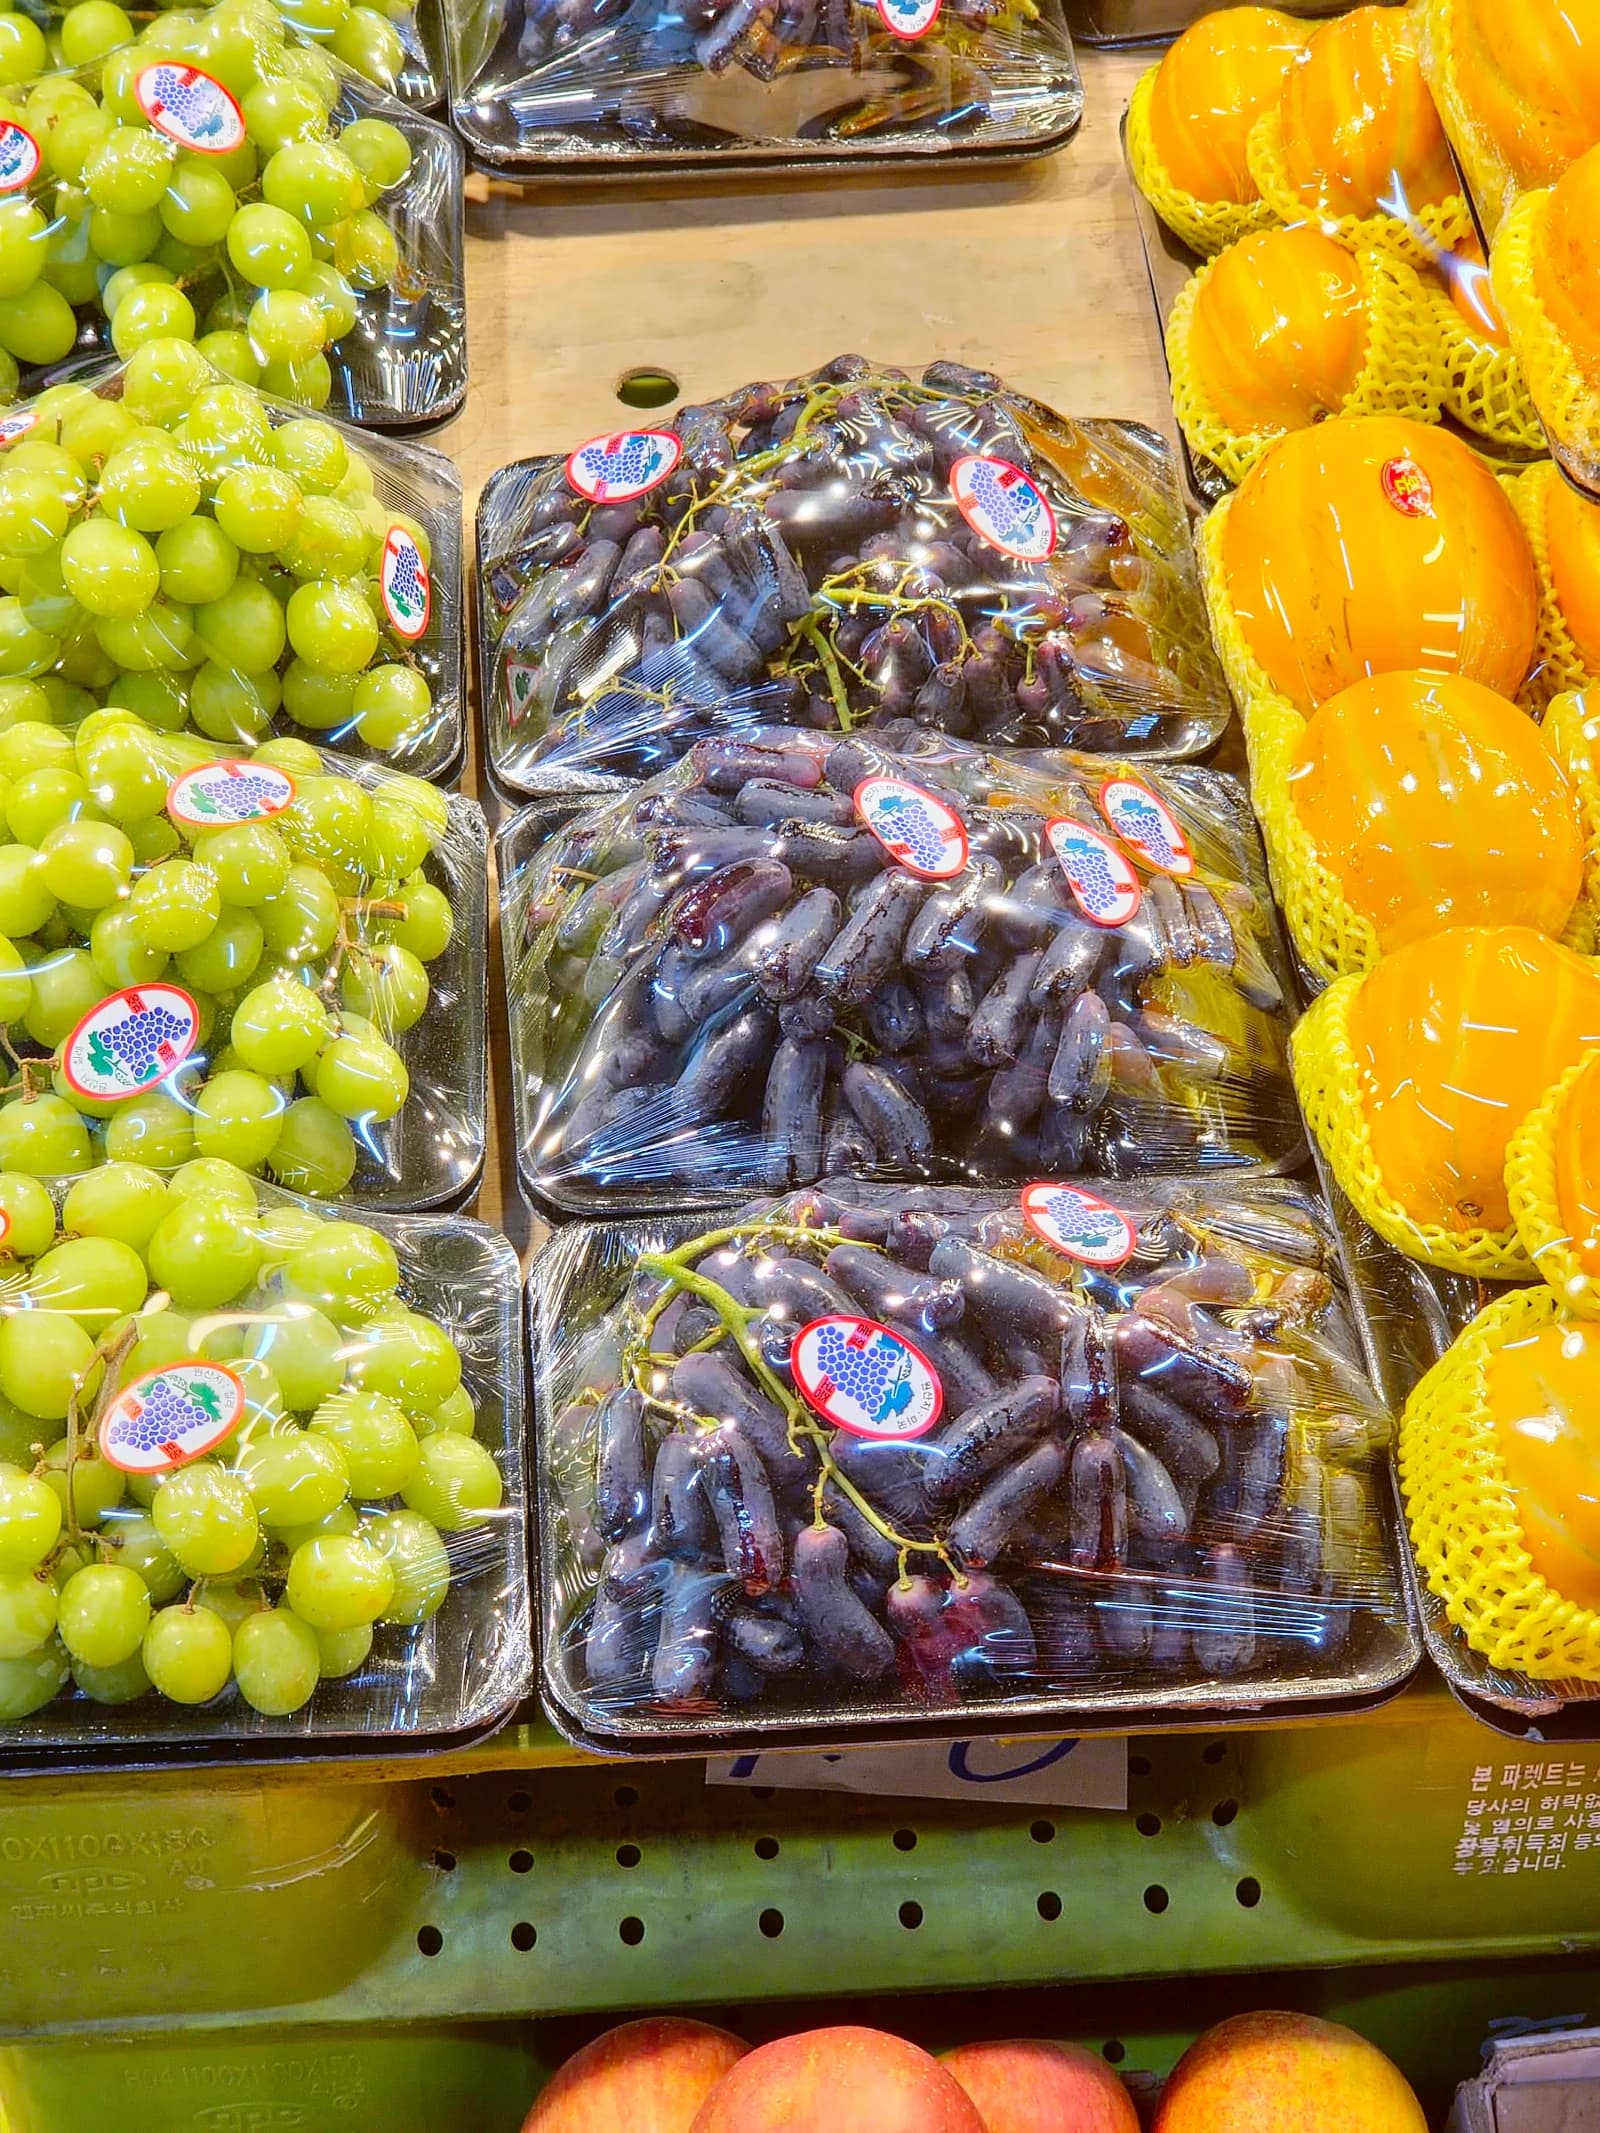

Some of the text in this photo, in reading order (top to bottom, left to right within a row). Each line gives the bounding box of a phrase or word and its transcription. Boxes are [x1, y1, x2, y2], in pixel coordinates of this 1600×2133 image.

[1471, 1766, 1493, 1791] 본
[1500, 1762, 1586, 1791] 파렛트는
[1466, 1797, 1530, 1816] 당사의
